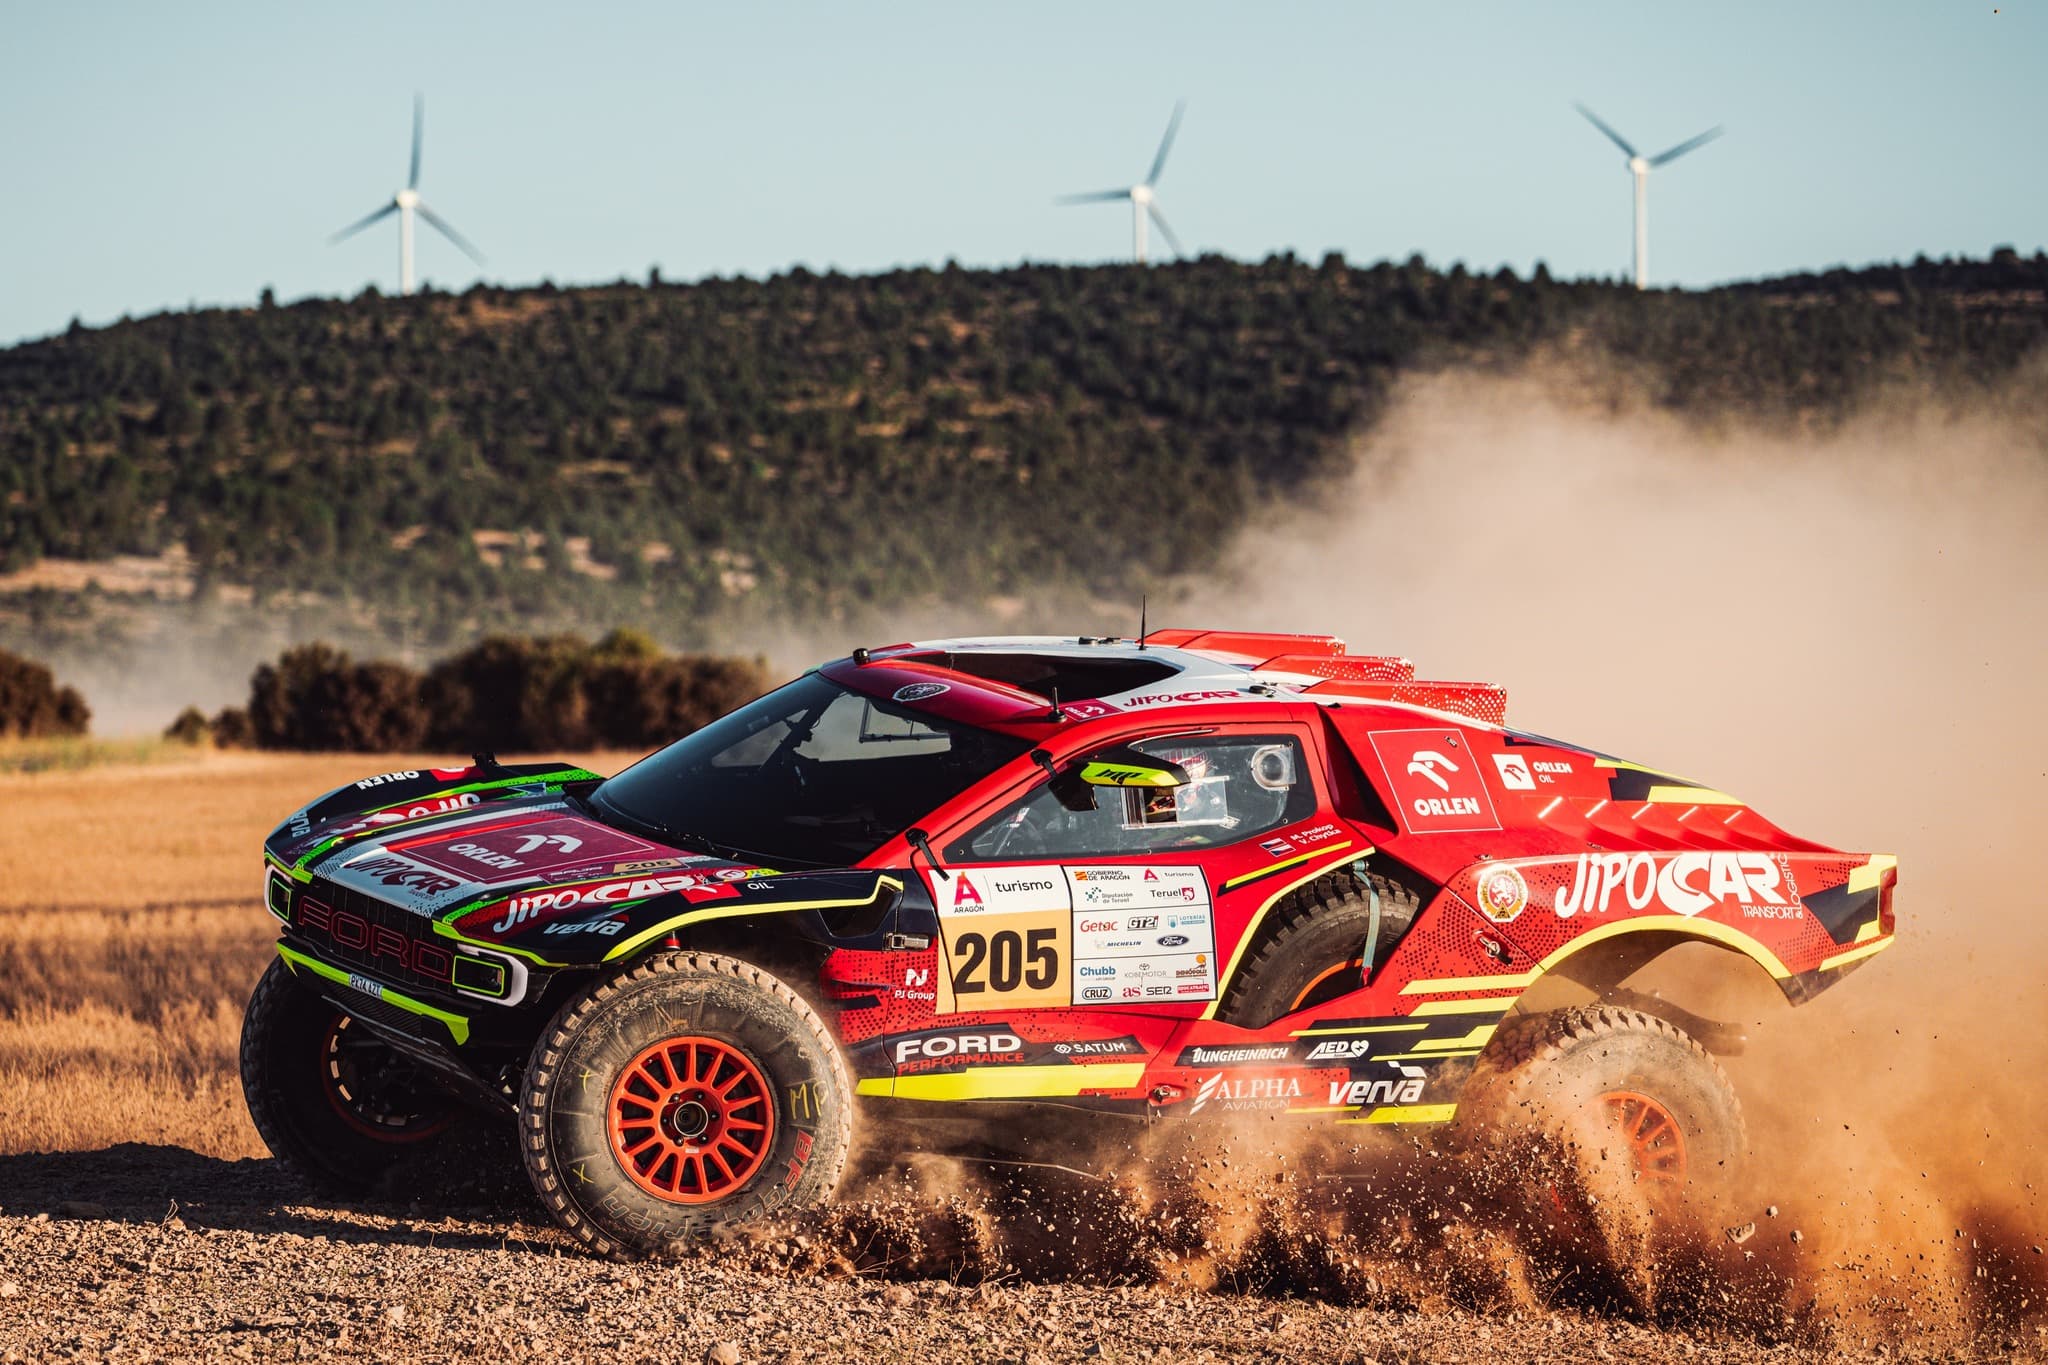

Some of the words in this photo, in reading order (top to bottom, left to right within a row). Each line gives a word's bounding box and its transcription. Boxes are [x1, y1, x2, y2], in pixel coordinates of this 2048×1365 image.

[1123, 690, 1241, 707] JIPOCAR
[1533, 761, 1573, 774] ORLEN
[1539, 774, 1555, 783] OIL
[1414, 797, 1481, 816] ORLEN
[448, 843, 525, 870] ORLEN
[625, 859, 672, 870] 205
[747, 881, 774, 890] OIL
[995, 880, 1054, 893] turismo
[1555, 852, 1786, 919] JIPOCAR
[1149, 888, 1182, 899] Teruel
[954, 905, 985, 914] ARAGÓN
[1741, 905, 1794, 919] TRANSPORT
[543, 918, 627, 937] verva
[1080, 919, 1119, 933] Getac
[298, 895, 454, 984] FORD
[1107, 940, 1142, 948] MICHELIN
[1162, 934, 1185, 947] Ford
[953, 928, 1059, 995] 205
[1080, 965, 1117, 977] Chubb
[894, 989, 905, 999] PJ
[907, 990, 935, 1002] Group
[1084, 987, 1110, 999] CRUZ
[1122, 985, 1142, 998] as
[896, 1034, 1022, 1064] FORD
[1074, 1042, 1127, 1054] SATUM
[1305, 1041, 1350, 1060] AED
[1192, 1047, 1289, 1064] JUNGHEINRICH
[897, 1052, 1025, 1074] PERFORMANCE
[1216, 1078, 1303, 1101] ALPHA
[1329, 1079, 1425, 1105] verva
[1222, 1099, 1291, 1112] AVIATION
